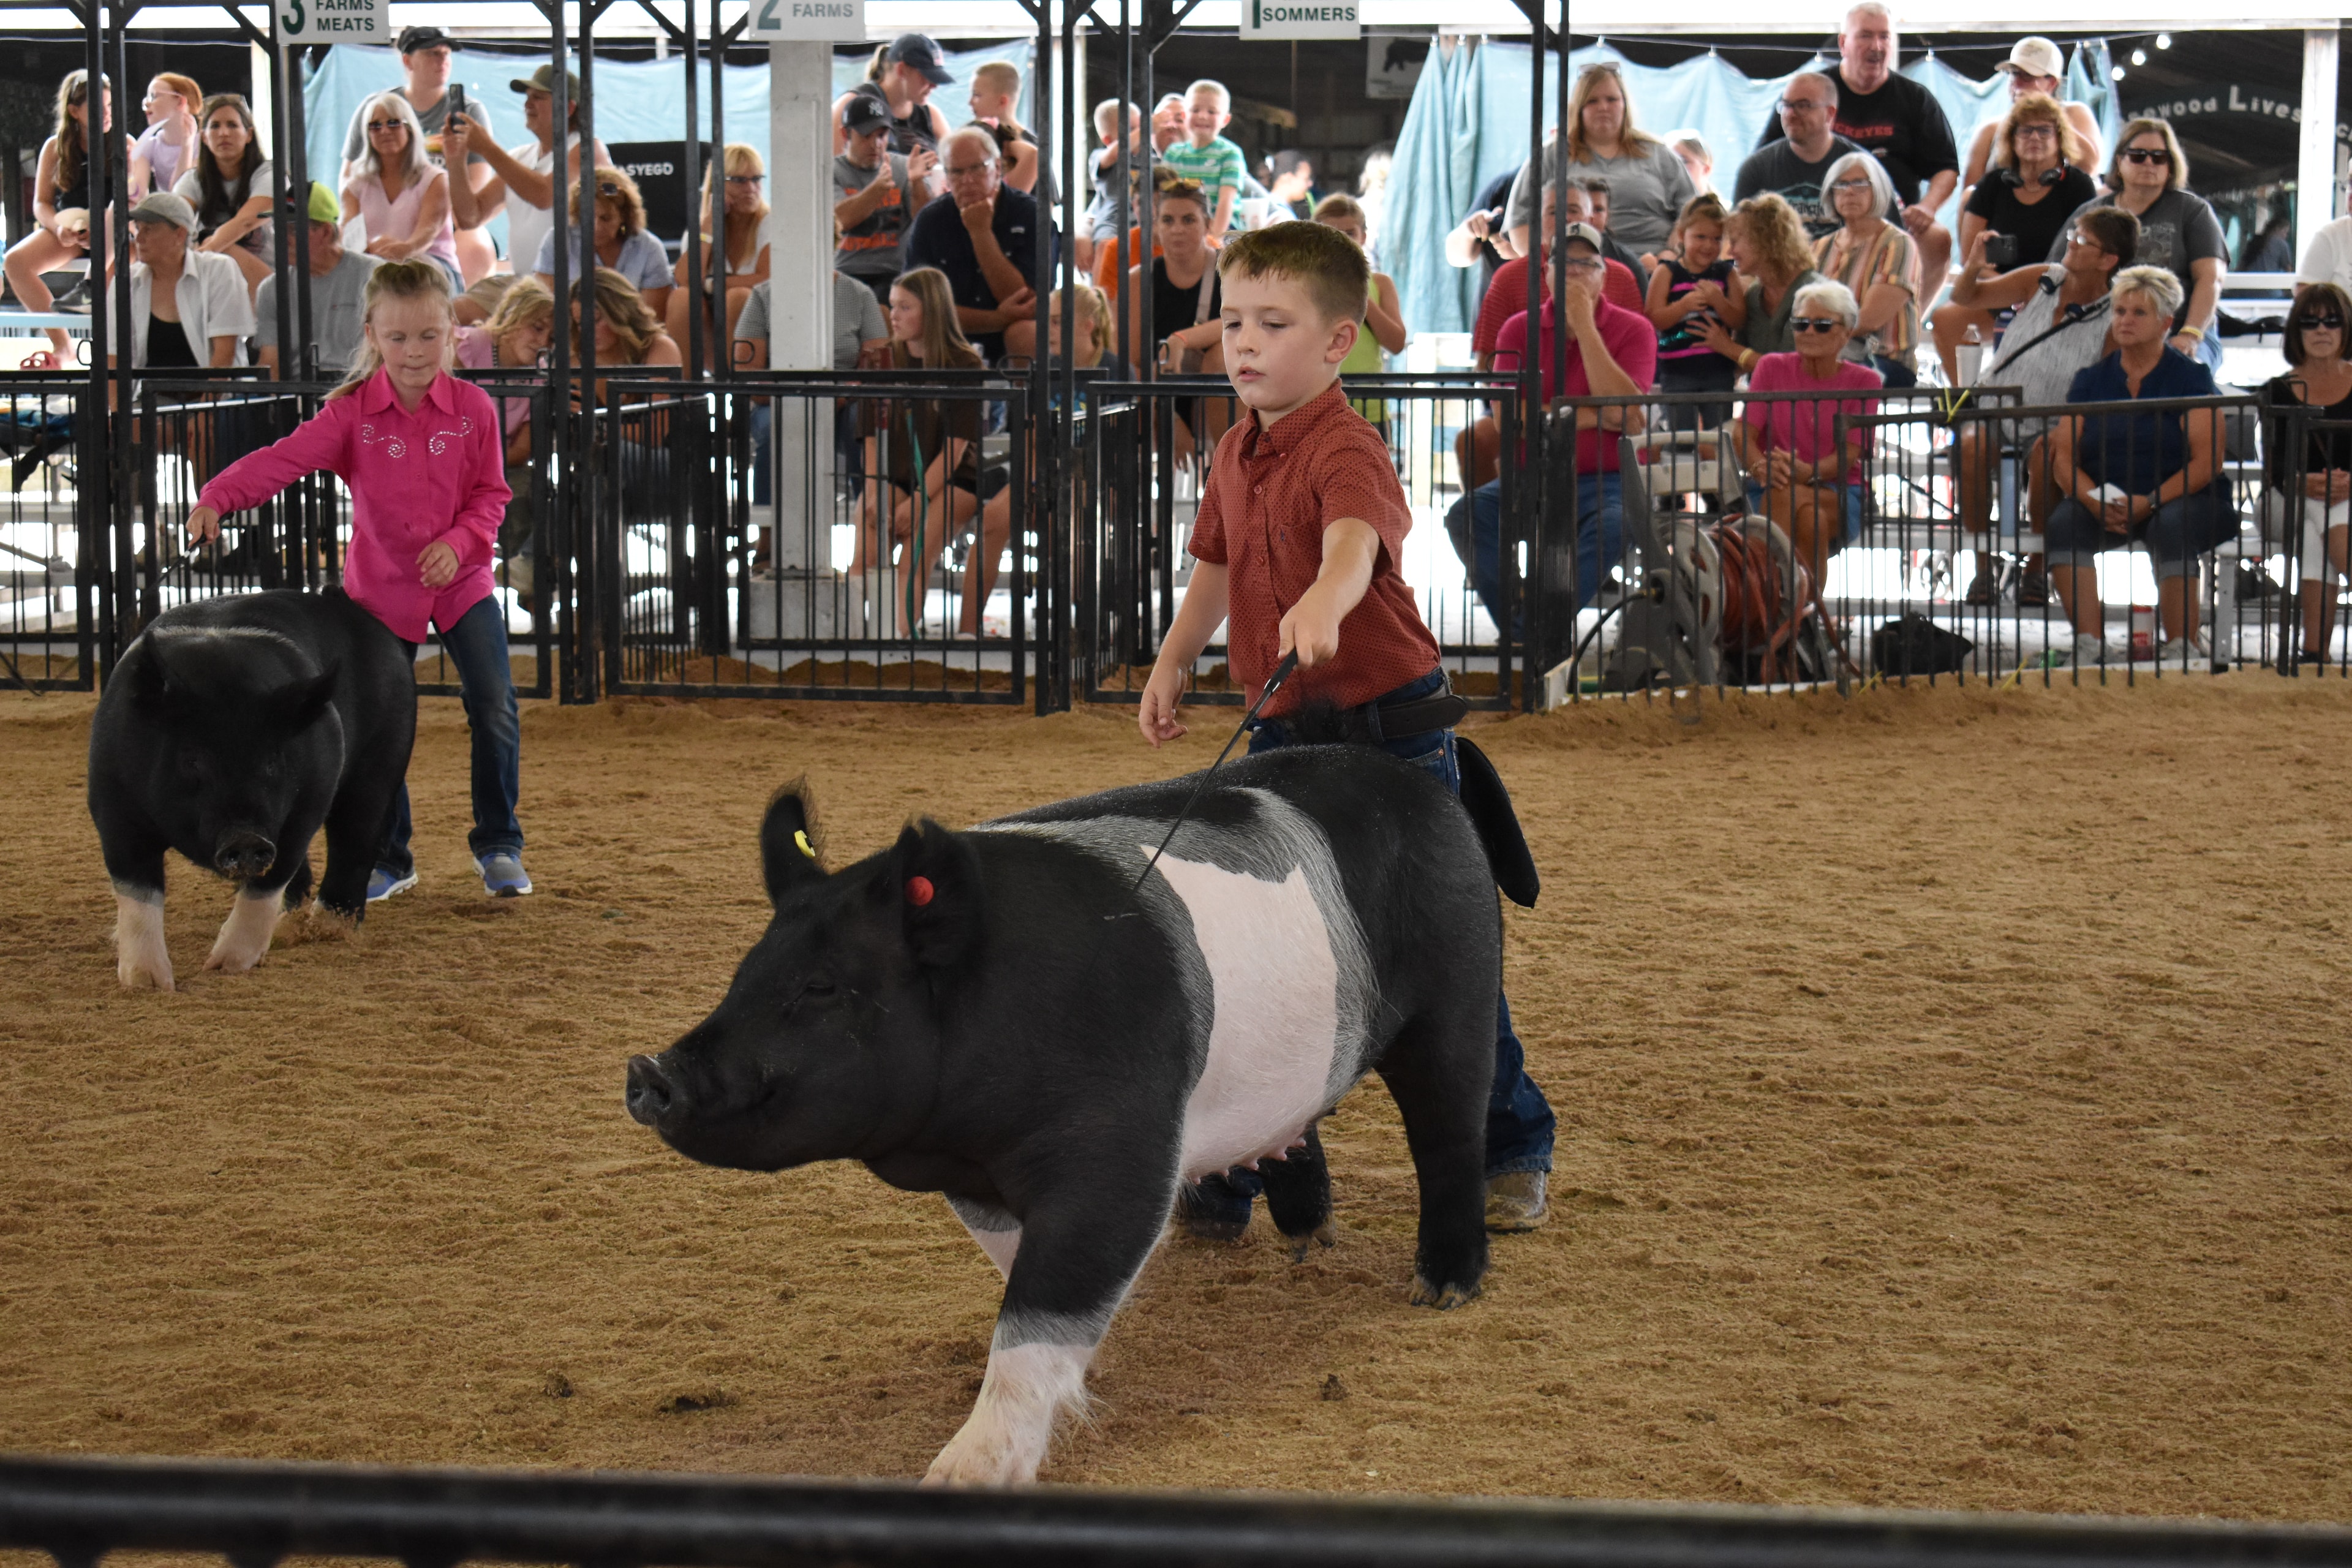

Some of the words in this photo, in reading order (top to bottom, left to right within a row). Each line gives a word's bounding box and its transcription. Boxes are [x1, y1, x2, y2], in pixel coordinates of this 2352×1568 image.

[316, 0, 374, 10] FARMS
[792, 4, 853, 17] FARMS
[282, 0, 305, 35] 3
[757, 0, 781, 30] 2
[1262, 7, 1355, 21] SOMMERS
[317, 18, 374, 31] MEATS
